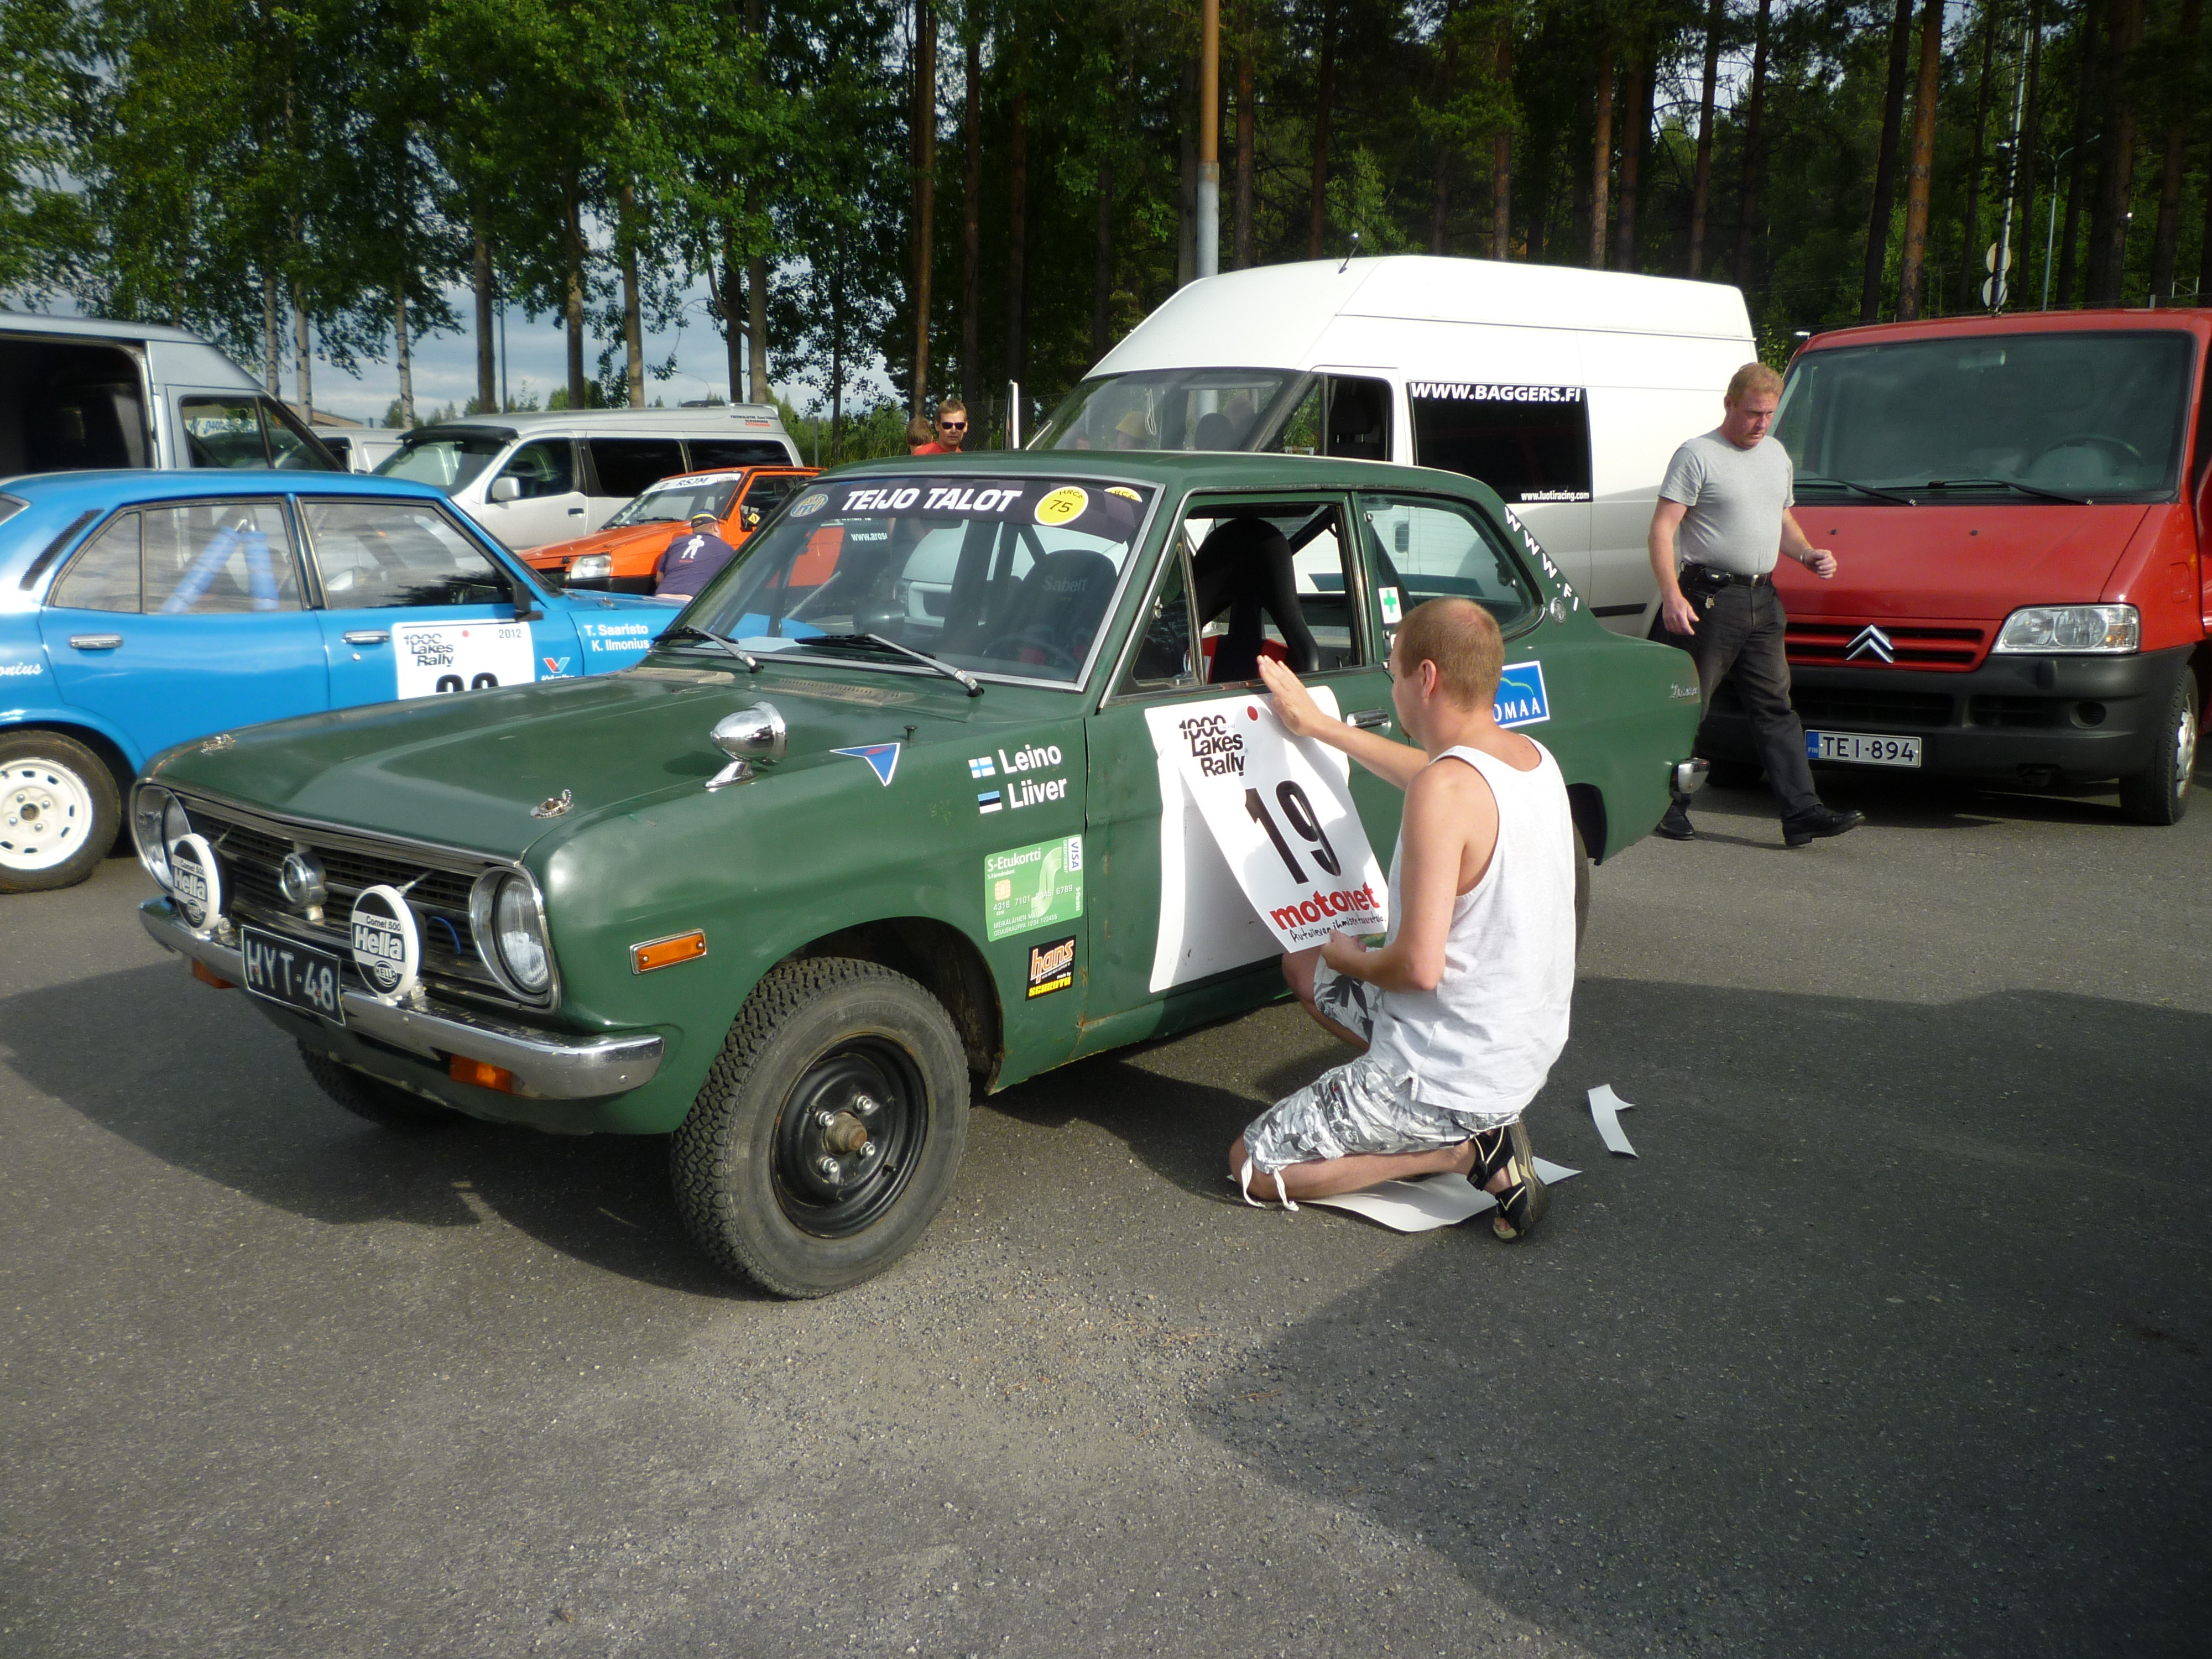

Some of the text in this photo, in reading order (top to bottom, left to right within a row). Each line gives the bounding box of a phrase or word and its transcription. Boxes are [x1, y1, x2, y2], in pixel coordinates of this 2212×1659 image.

[1411, 382, 1580, 402] WWW.BAGGERS.FI
[842, 488, 920, 510] TEIJO
[923, 488, 1022, 512] TALOT
[1049, 499, 1073, 513] 75
[1521, 491, 1589, 502] www.luotiracing.com
[1043, 576, 1088, 592] Sabelt
[498, 629, 522, 638] 2012
[583, 623, 649, 636] T. Saaristo
[411, 644, 454, 654] Lakes
[592, 638, 650, 651] K. Ilmonius
[417, 654, 454, 667] Rally
[1191, 733, 1243, 757] Lakes
[1823, 736, 1914, 761] TEI-894
[998, 744, 1061, 774] Leino
[1201, 752, 1245, 777] Rally
[1008, 779, 1067, 808] Liiver
[1245, 780, 1342, 884] 19
[988, 847, 1041, 872] S-Etukortti
[174, 868, 206, 900] Hella
[993, 901, 1010, 911] 4318
[1015, 895, 1031, 906] 7101
[1056, 885, 1073, 895] 6789
[1270, 881, 1380, 930] motonet
[367, 916, 401, 931] Comet 500
[994, 924, 1026, 937] OSUUSKAUPPA
[355, 925, 403, 960] Hella
[376, 967, 396, 980] HELLA
[1031, 940, 1074, 984] hans
[247, 940, 335, 1011] HYT-48
